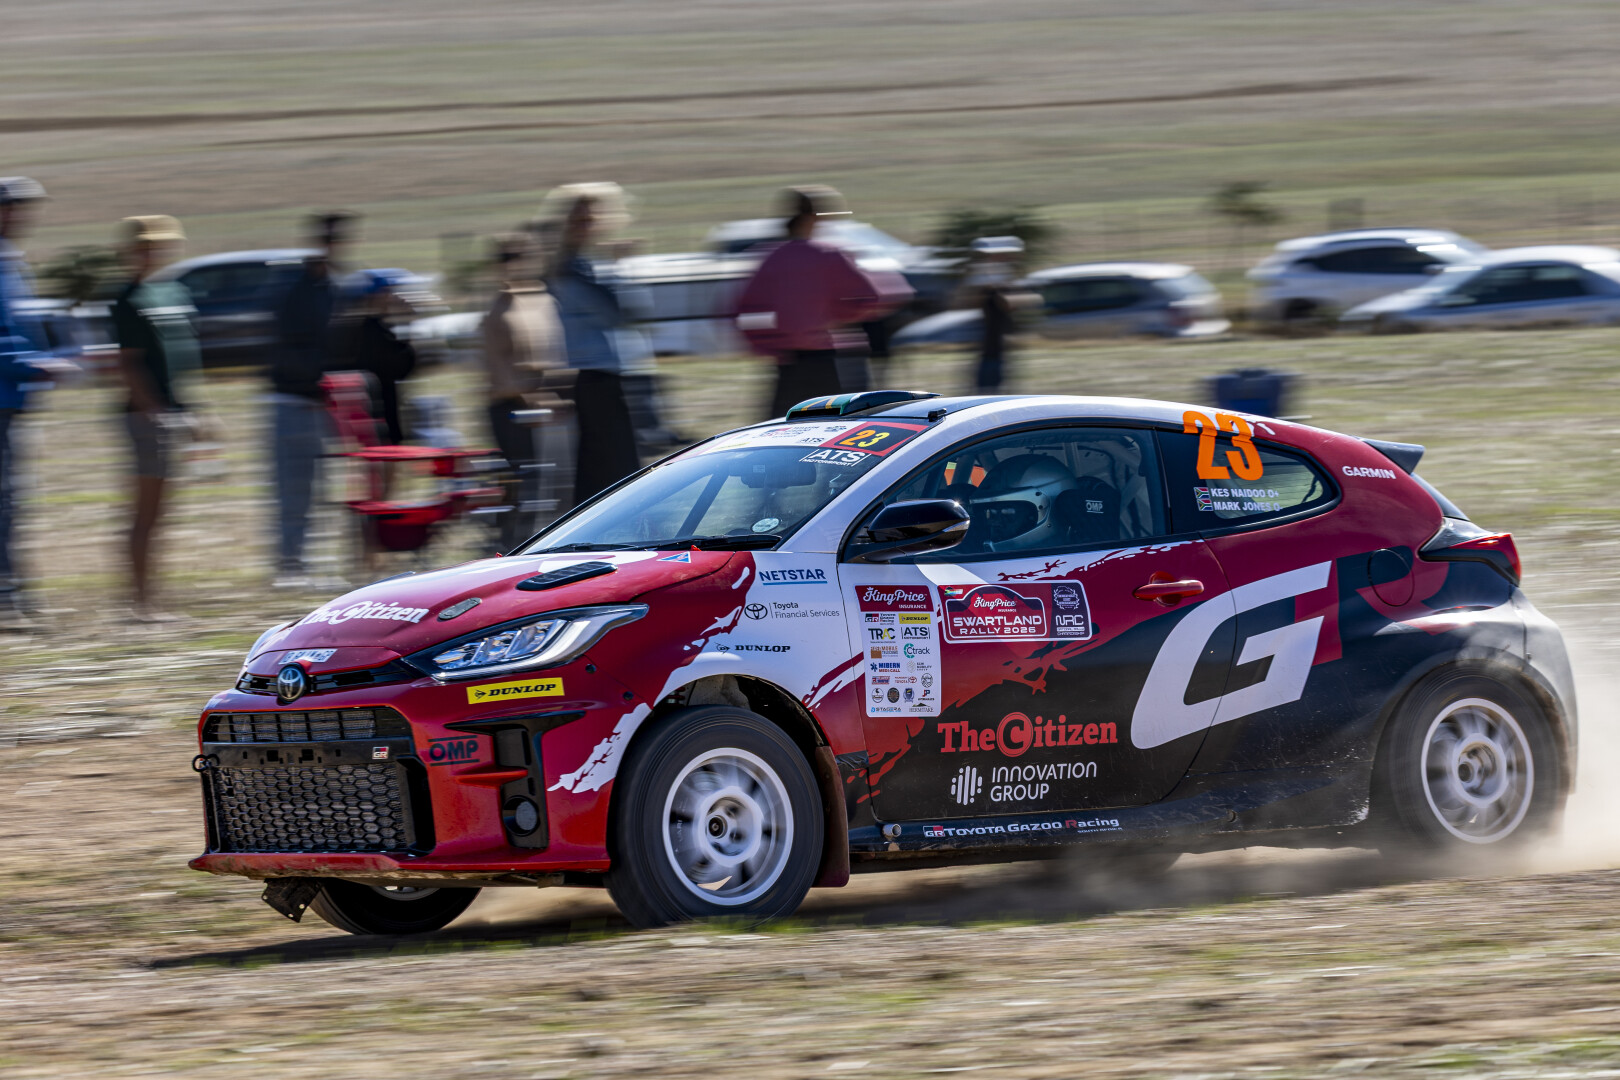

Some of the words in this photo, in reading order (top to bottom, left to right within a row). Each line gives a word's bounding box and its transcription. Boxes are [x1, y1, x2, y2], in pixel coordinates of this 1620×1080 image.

[839, 429, 890, 447] 23
[1183, 410, 1263, 480] 23
[809, 449, 866, 463] ATS
[1342, 465, 1396, 480] GARMIN
[1210, 488, 1230, 498] KES
[1231, 488, 1266, 498] NAIDOO
[1086, 501, 1104, 512] OMP
[1213, 501, 1241, 511] MARK
[1242, 502, 1271, 511] JONES
[759, 569, 826, 581] NETSTAR
[773, 602, 799, 611] Toyota
[775, 610, 809, 618] Financial
[810, 609, 840, 617] Services
[953, 615, 1042, 627] SWARTLAND
[1055, 614, 1084, 626] NRC
[868, 628, 896, 640] TRAC
[904, 627, 928, 636] ATS
[960, 627, 1001, 635] RALLY
[735, 644, 791, 652] DUNLOP
[906, 646, 930, 655] Ctrack
[488, 683, 556, 697] DUNLOP
[429, 739, 479, 761] OMP
[992, 761, 1097, 782] INNOVATION
[990, 783, 1050, 802] GROUP
[944, 826, 1005, 837] TOYOTA
[1007, 821, 1063, 832] GAZOO
[1065, 818, 1120, 830] Racing
